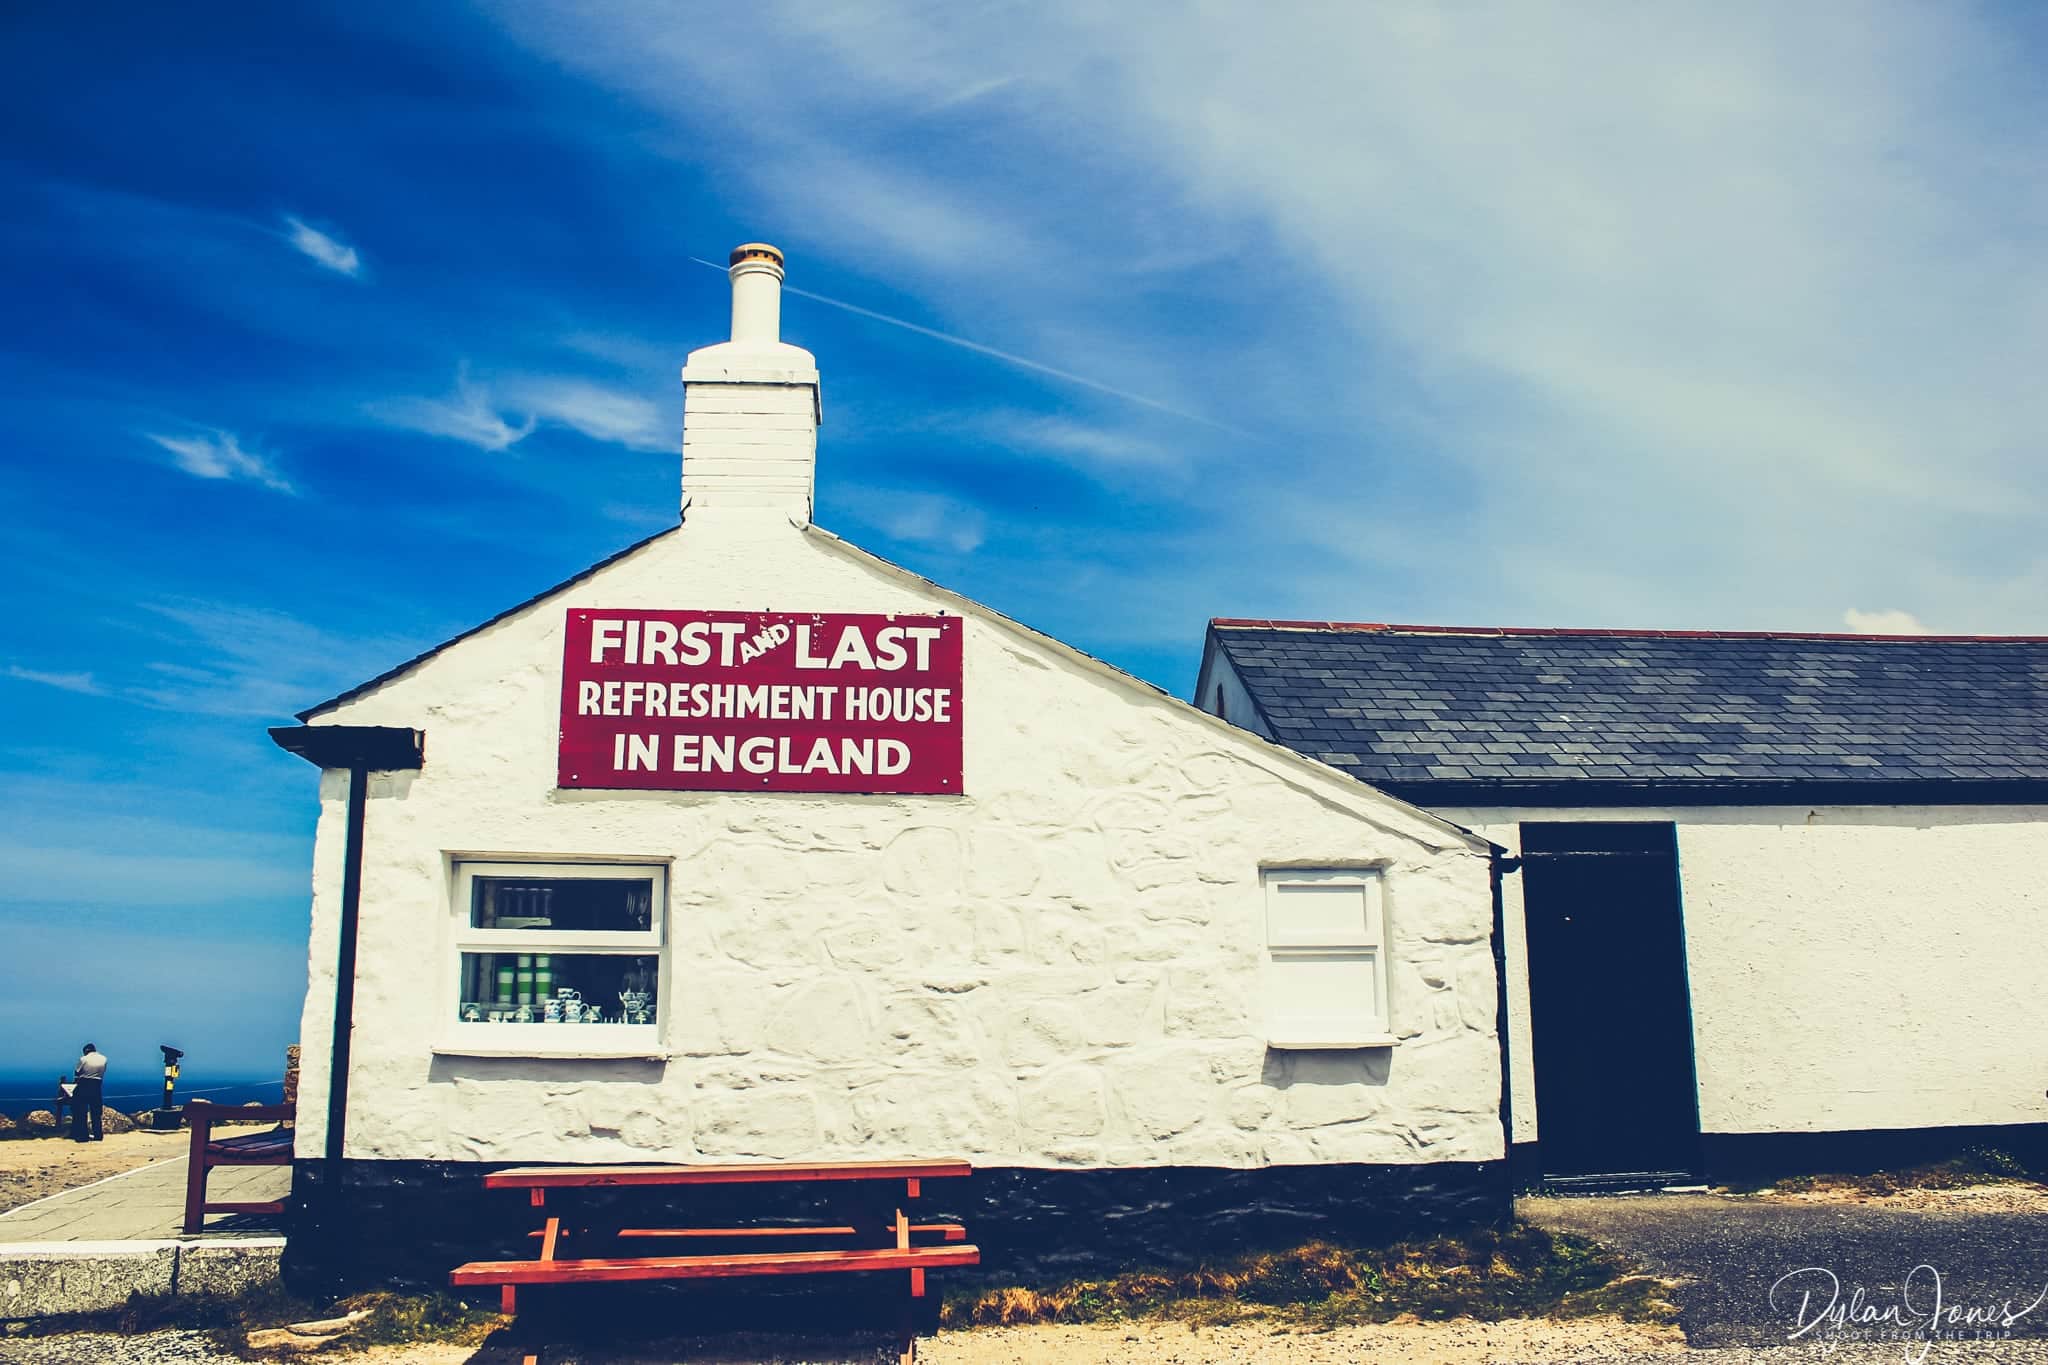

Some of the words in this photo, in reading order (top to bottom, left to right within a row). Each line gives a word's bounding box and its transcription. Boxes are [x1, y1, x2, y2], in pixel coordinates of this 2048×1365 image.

[590, 619, 746, 667] FIRST
[740, 623, 790, 664] AND
[795, 625, 942, 671] LAST
[578, 681, 838, 721] REFRESHMENT
[845, 687, 951, 723] HOUSE
[613, 733, 660, 771] IN
[673, 734, 911, 775] ENGLAND
